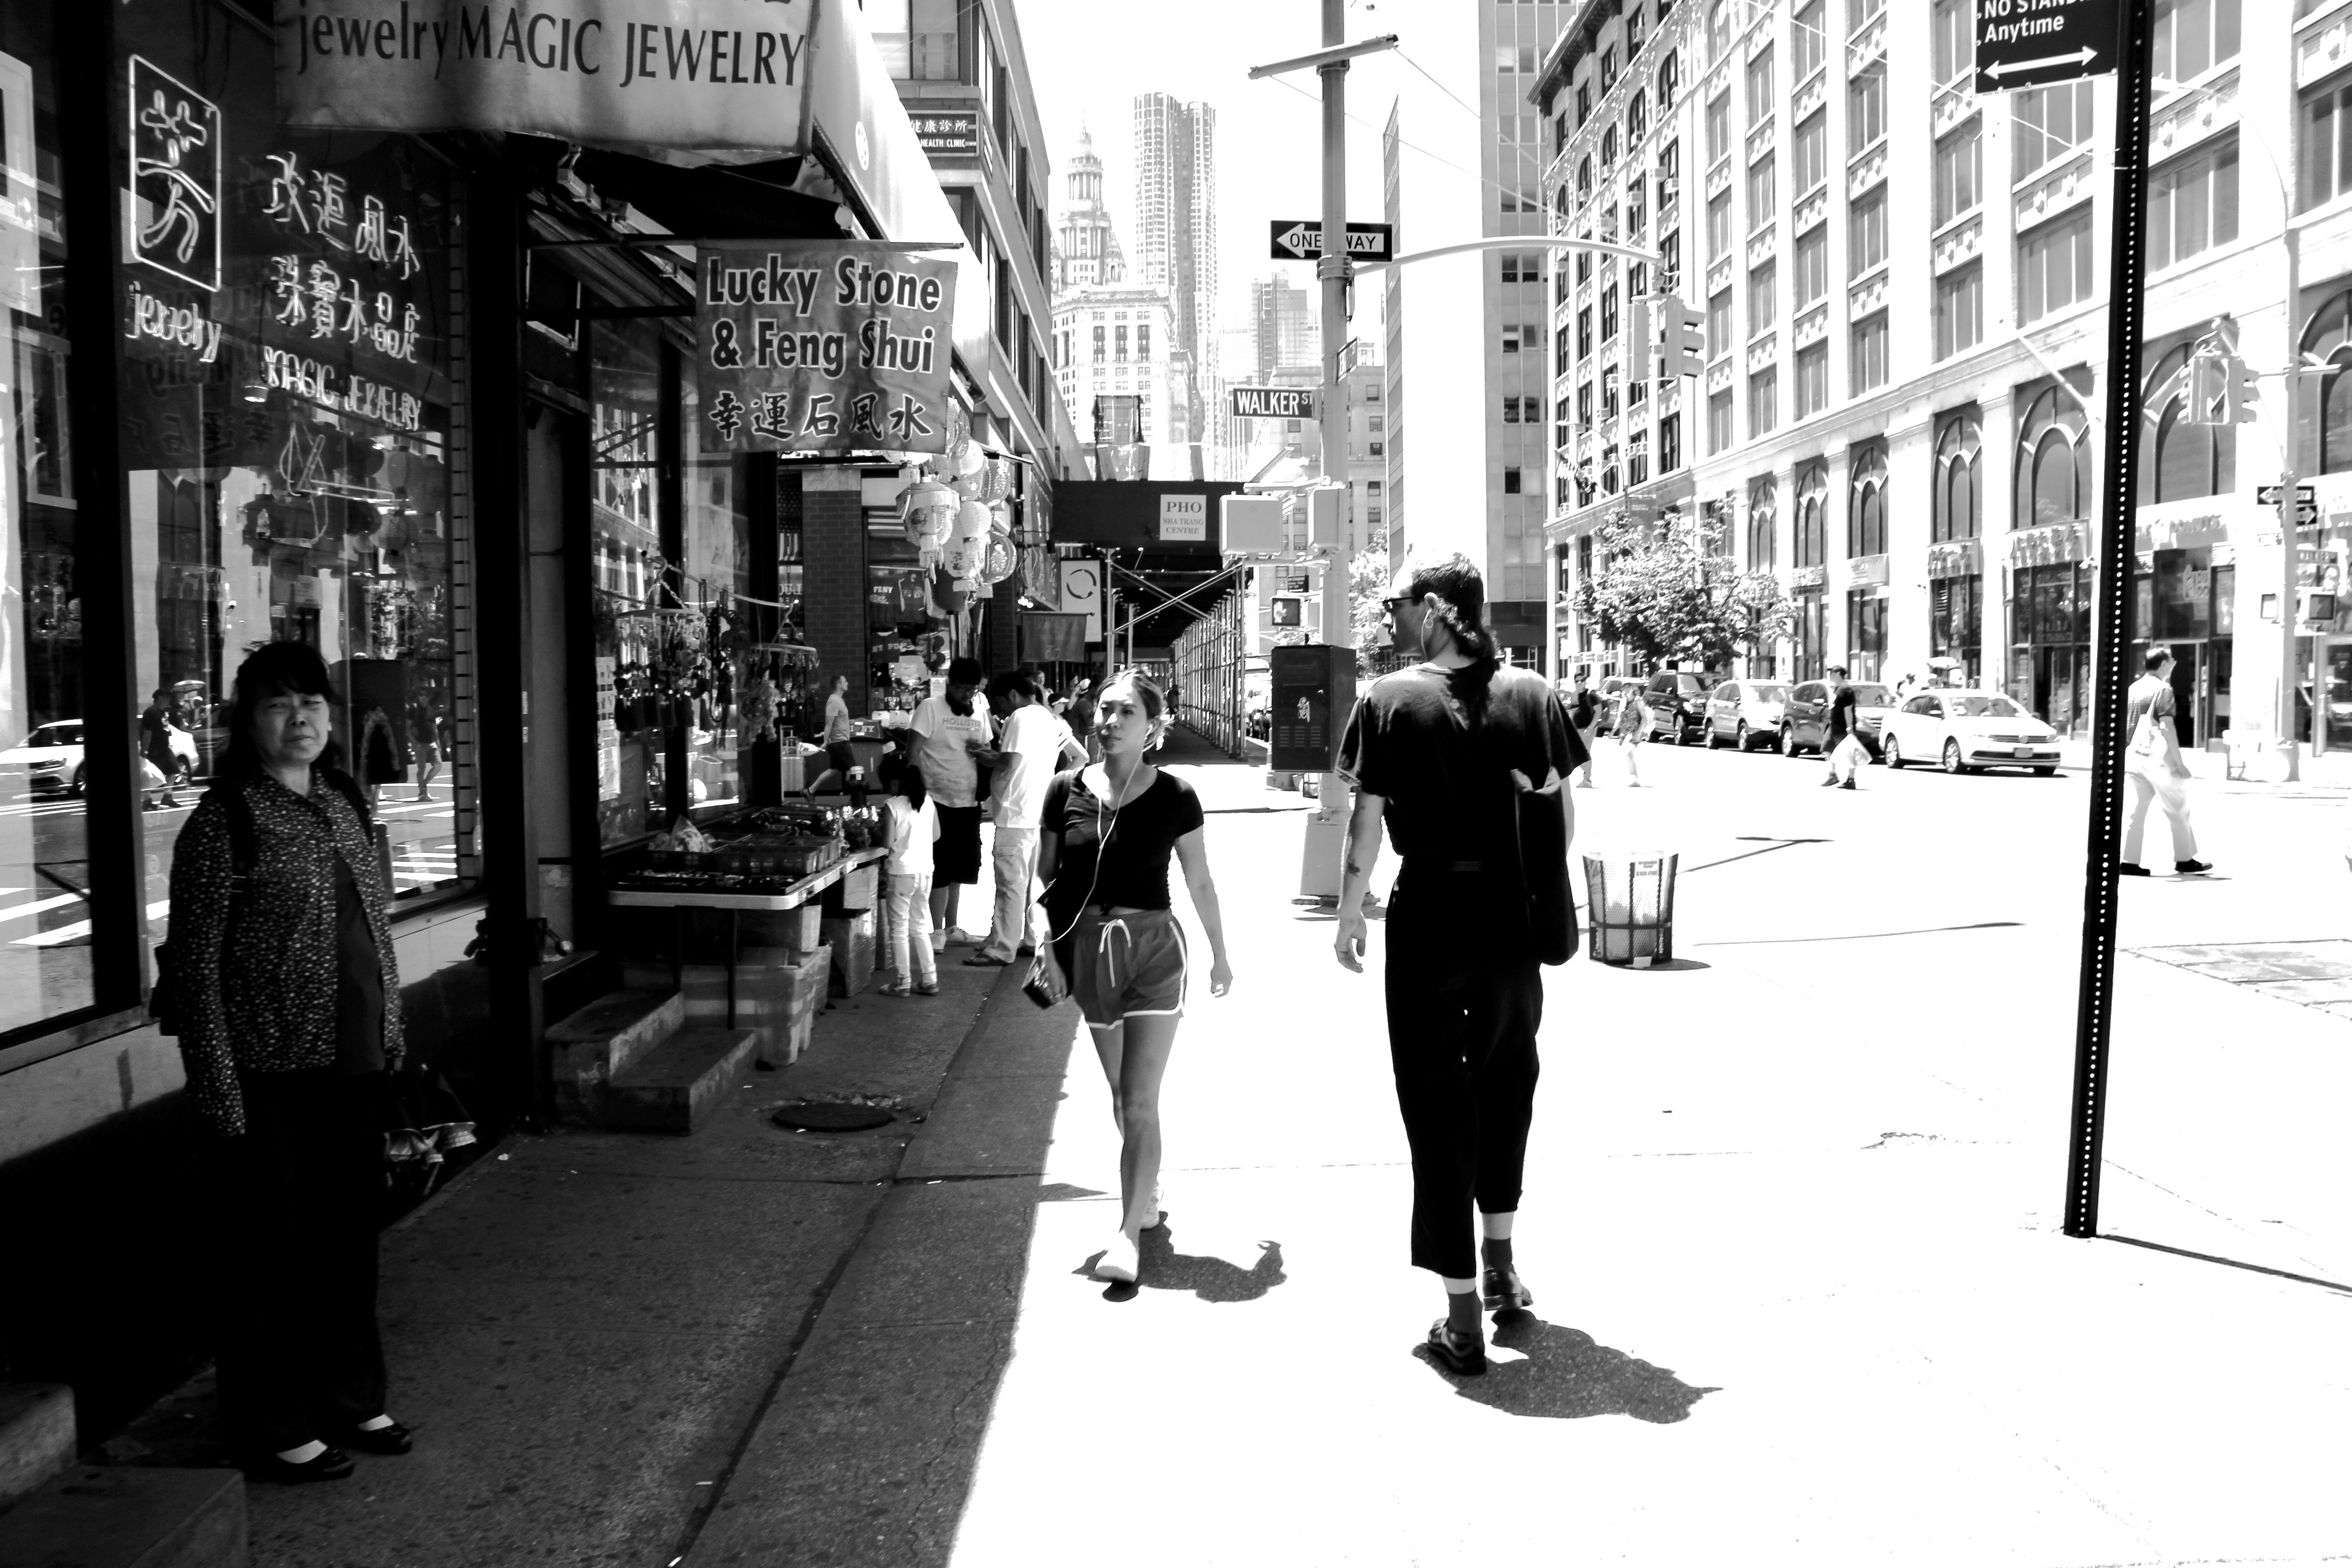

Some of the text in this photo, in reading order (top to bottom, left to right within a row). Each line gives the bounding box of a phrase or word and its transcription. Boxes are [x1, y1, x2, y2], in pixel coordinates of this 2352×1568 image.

[1984, 0, 2011, 19] NO
[1984, 15, 2064, 43] Anytime
[297, 0, 805, 88] jewelry MAGIC JEWELRY
[921, 139, 966, 147] HEALTH CLINIC
[1290, 233, 1322, 248] ONE
[706, 254, 942, 317] Lucky Stone
[124, 281, 221, 363] jewelry
[712, 318, 935, 379] & Feng Shui
[262, 345, 335, 405] MAGIC
[708, 390, 934, 442] 幸運石風水
[1237, 391, 1299, 416] WALKER
[1166, 501, 1202, 513] PHO
